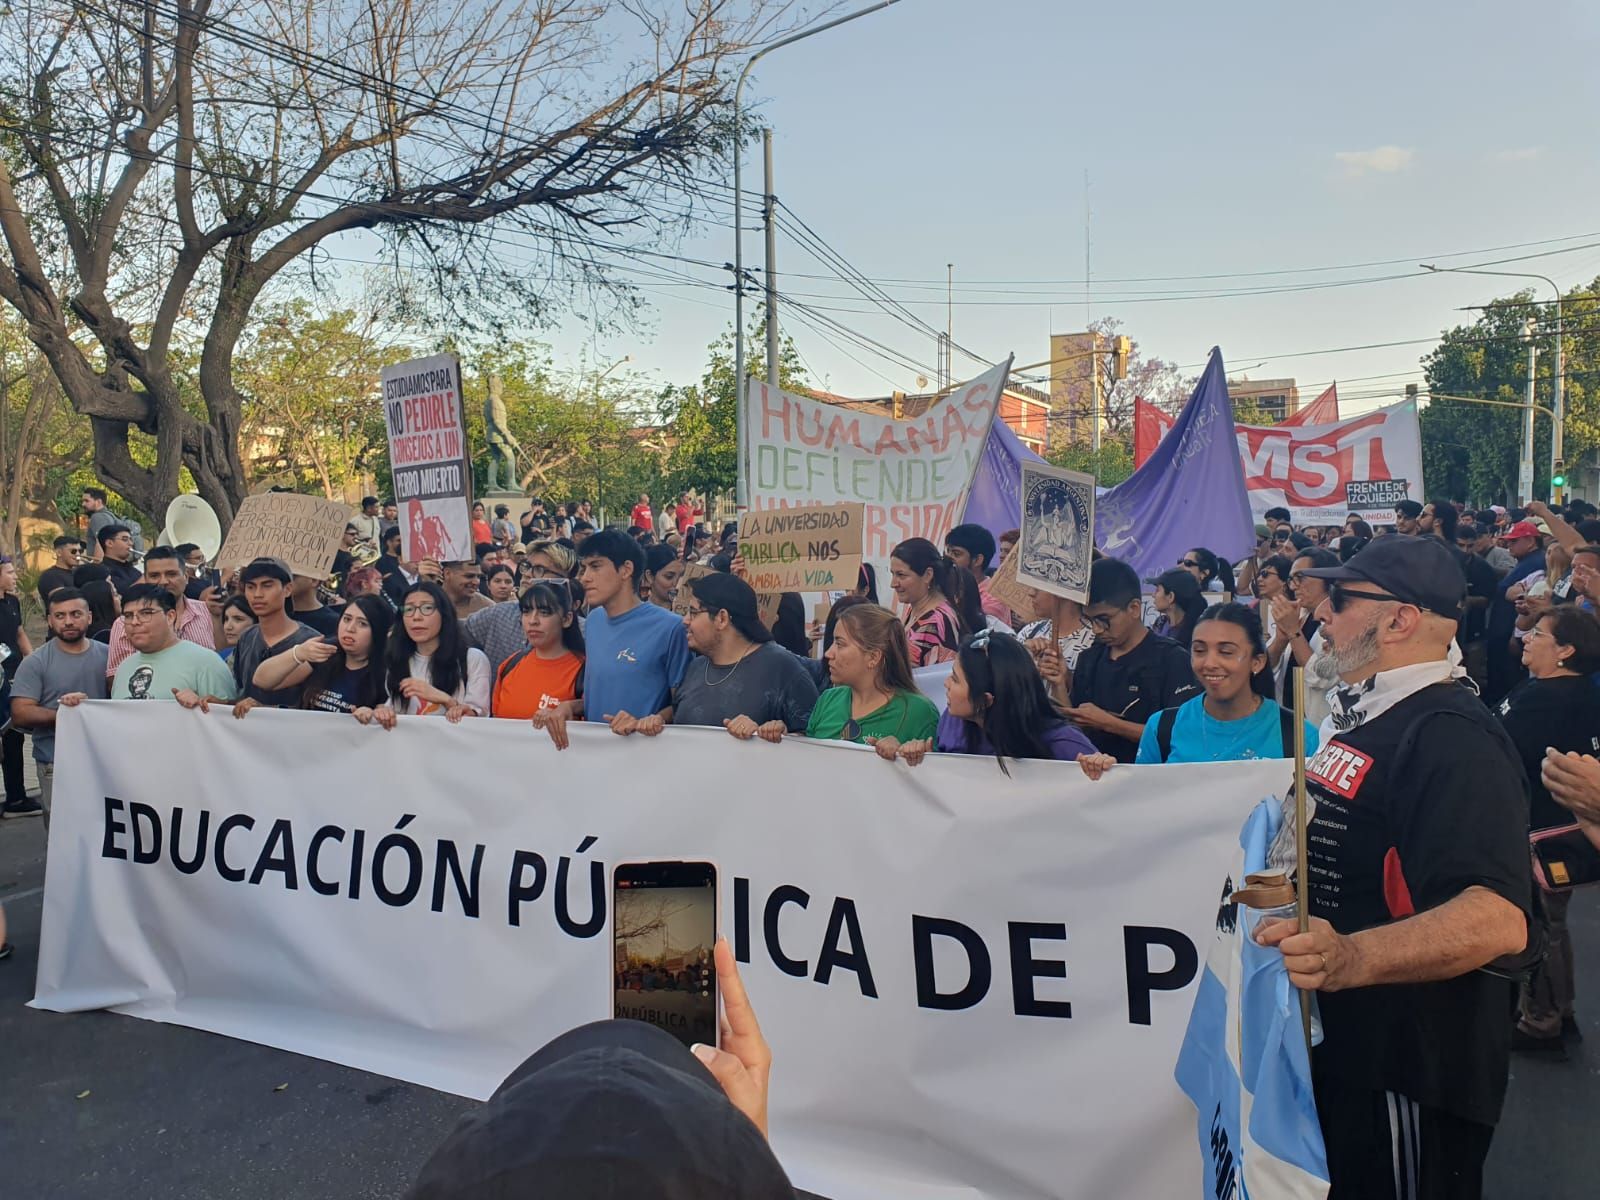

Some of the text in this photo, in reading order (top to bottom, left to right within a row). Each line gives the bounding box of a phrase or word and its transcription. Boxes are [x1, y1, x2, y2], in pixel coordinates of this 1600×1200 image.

[430, 368, 453, 391] PARA
[388, 391, 457, 436] NO PEDIRLE
[760, 383, 994, 456] HUMANAS
[393, 430, 460, 465] CONSEJOS A UN
[396, 465, 461, 497] PERRO MUERTO
[1346, 481, 1405, 494] FRENTE DE
[262, 494, 306, 513] JOVEN
[1347, 491, 1407, 504] IZQUIERDA
[739, 510, 850, 539] LA UNIVERSIDAD
[739, 540, 840, 565] PUBLICA NOS
[784, 568, 800, 588] LA
[804, 569, 834, 586] VIDA
[101, 797, 487, 919] EDUCACIÓN
[508, 836, 880, 1000] PÚICA
[911, 914, 1072, 1019] DE
